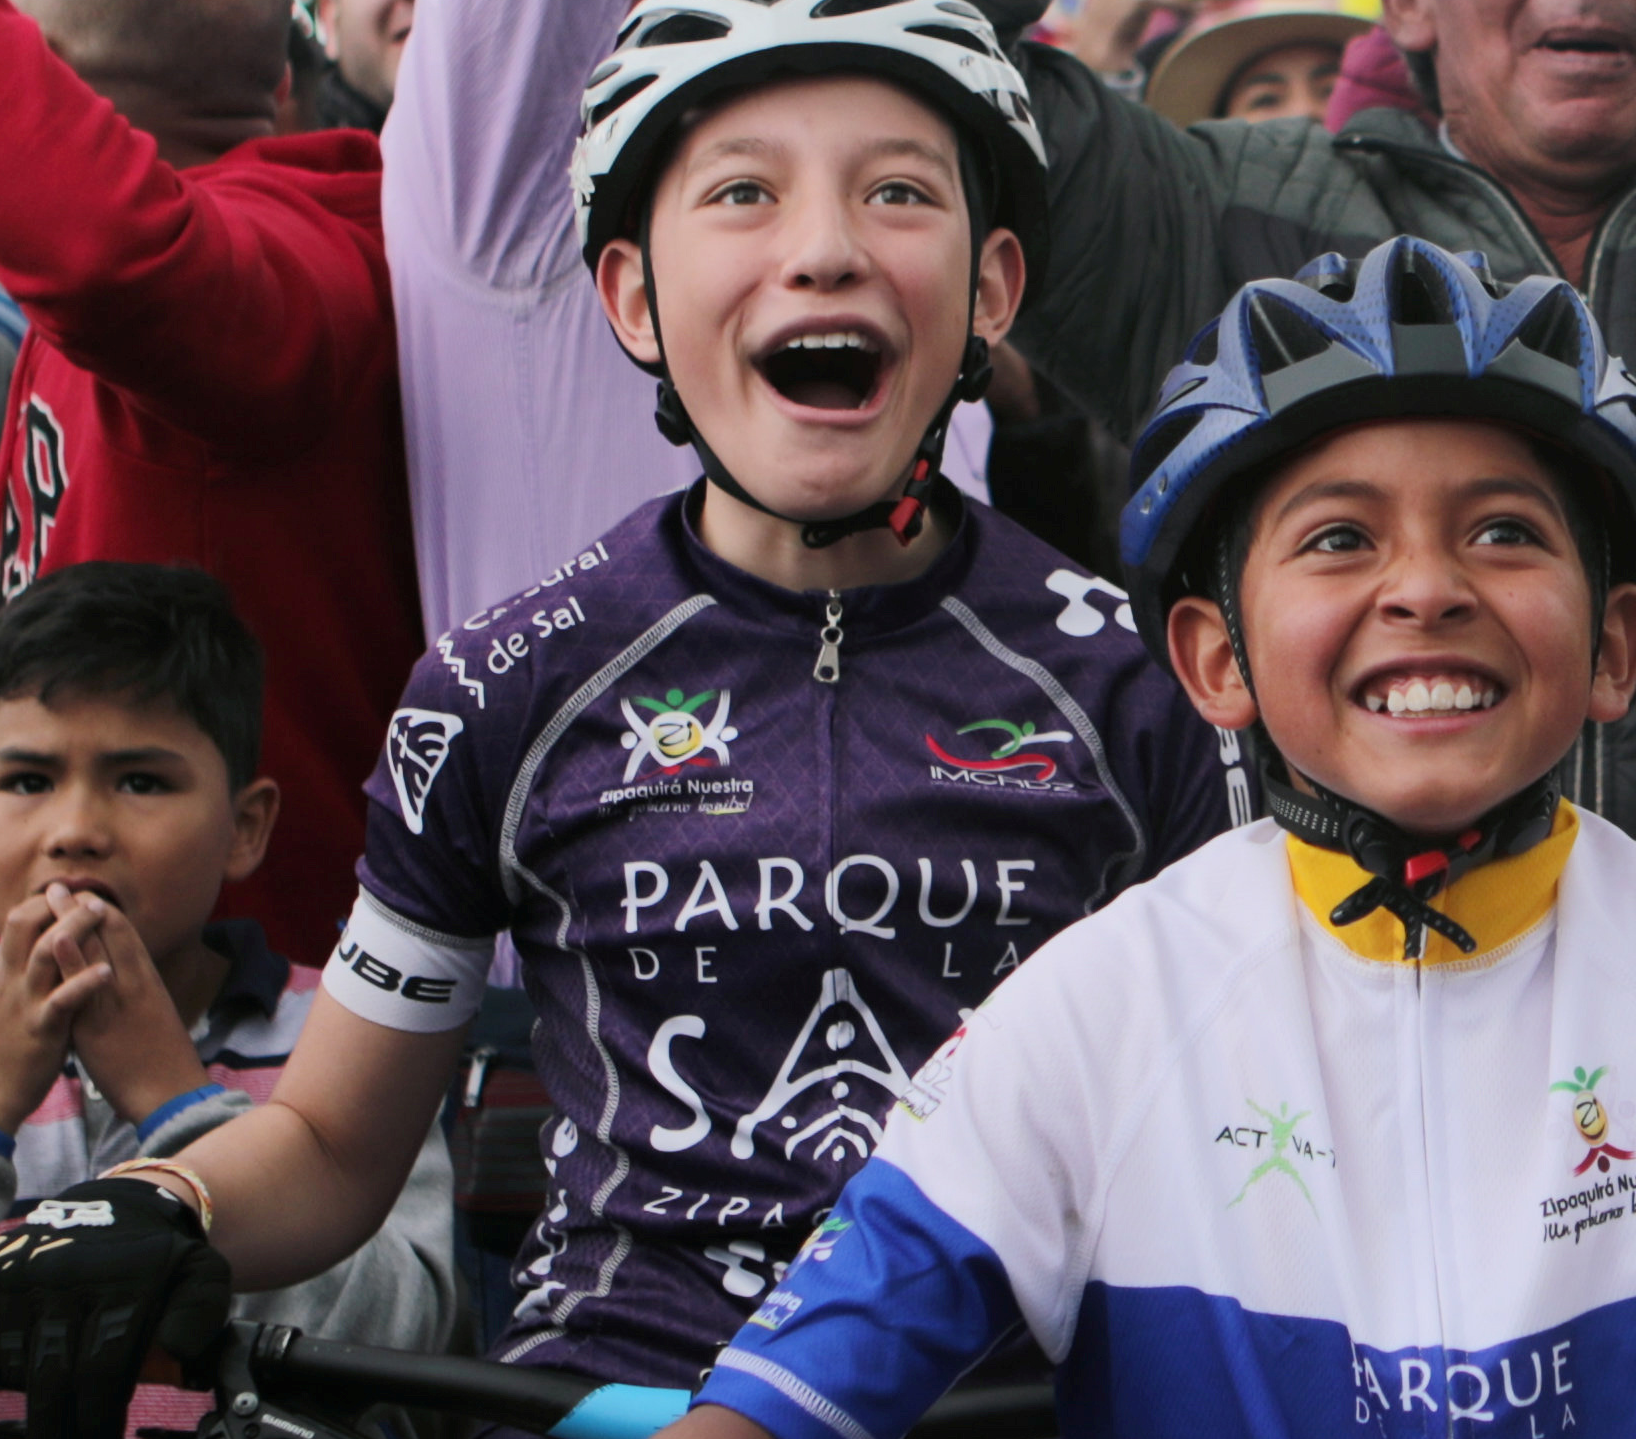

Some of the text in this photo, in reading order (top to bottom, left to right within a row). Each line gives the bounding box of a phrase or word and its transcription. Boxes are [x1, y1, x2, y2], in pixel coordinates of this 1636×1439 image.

[487, 638, 529, 674] de
[687, 777, 754, 796] Nuestra
[620, 853, 1036, 940] PARQUE
[338, 940, 458, 1004] UBE
[628, 946, 719, 984] DE
[1540, 1176, 1615, 1219] Zipaquirá
